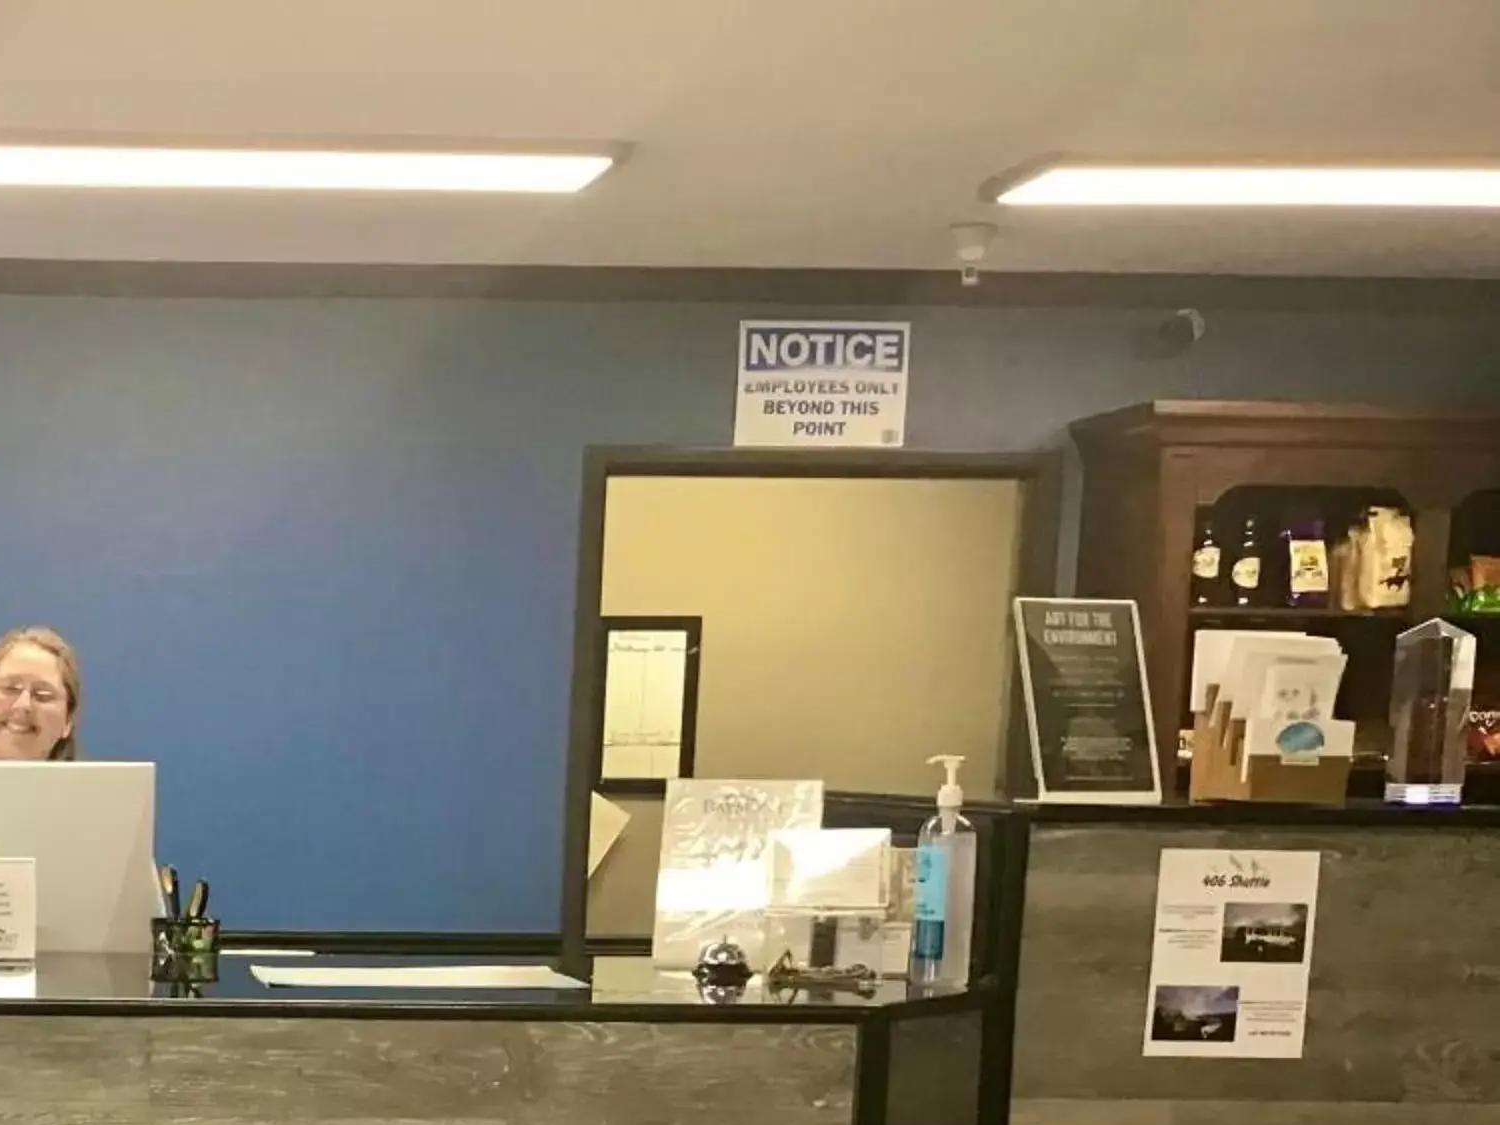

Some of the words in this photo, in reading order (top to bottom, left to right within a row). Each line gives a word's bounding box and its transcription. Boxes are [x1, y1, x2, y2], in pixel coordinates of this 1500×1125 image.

[750, 333, 899, 367] NOTICE
[744, 380, 849, 395] EMPLOYEES
[855, 381, 899, 395] ONLY
[763, 400, 835, 415] BEYOND
[842, 401, 880, 415] THIS
[792, 421, 847, 436] POINT
